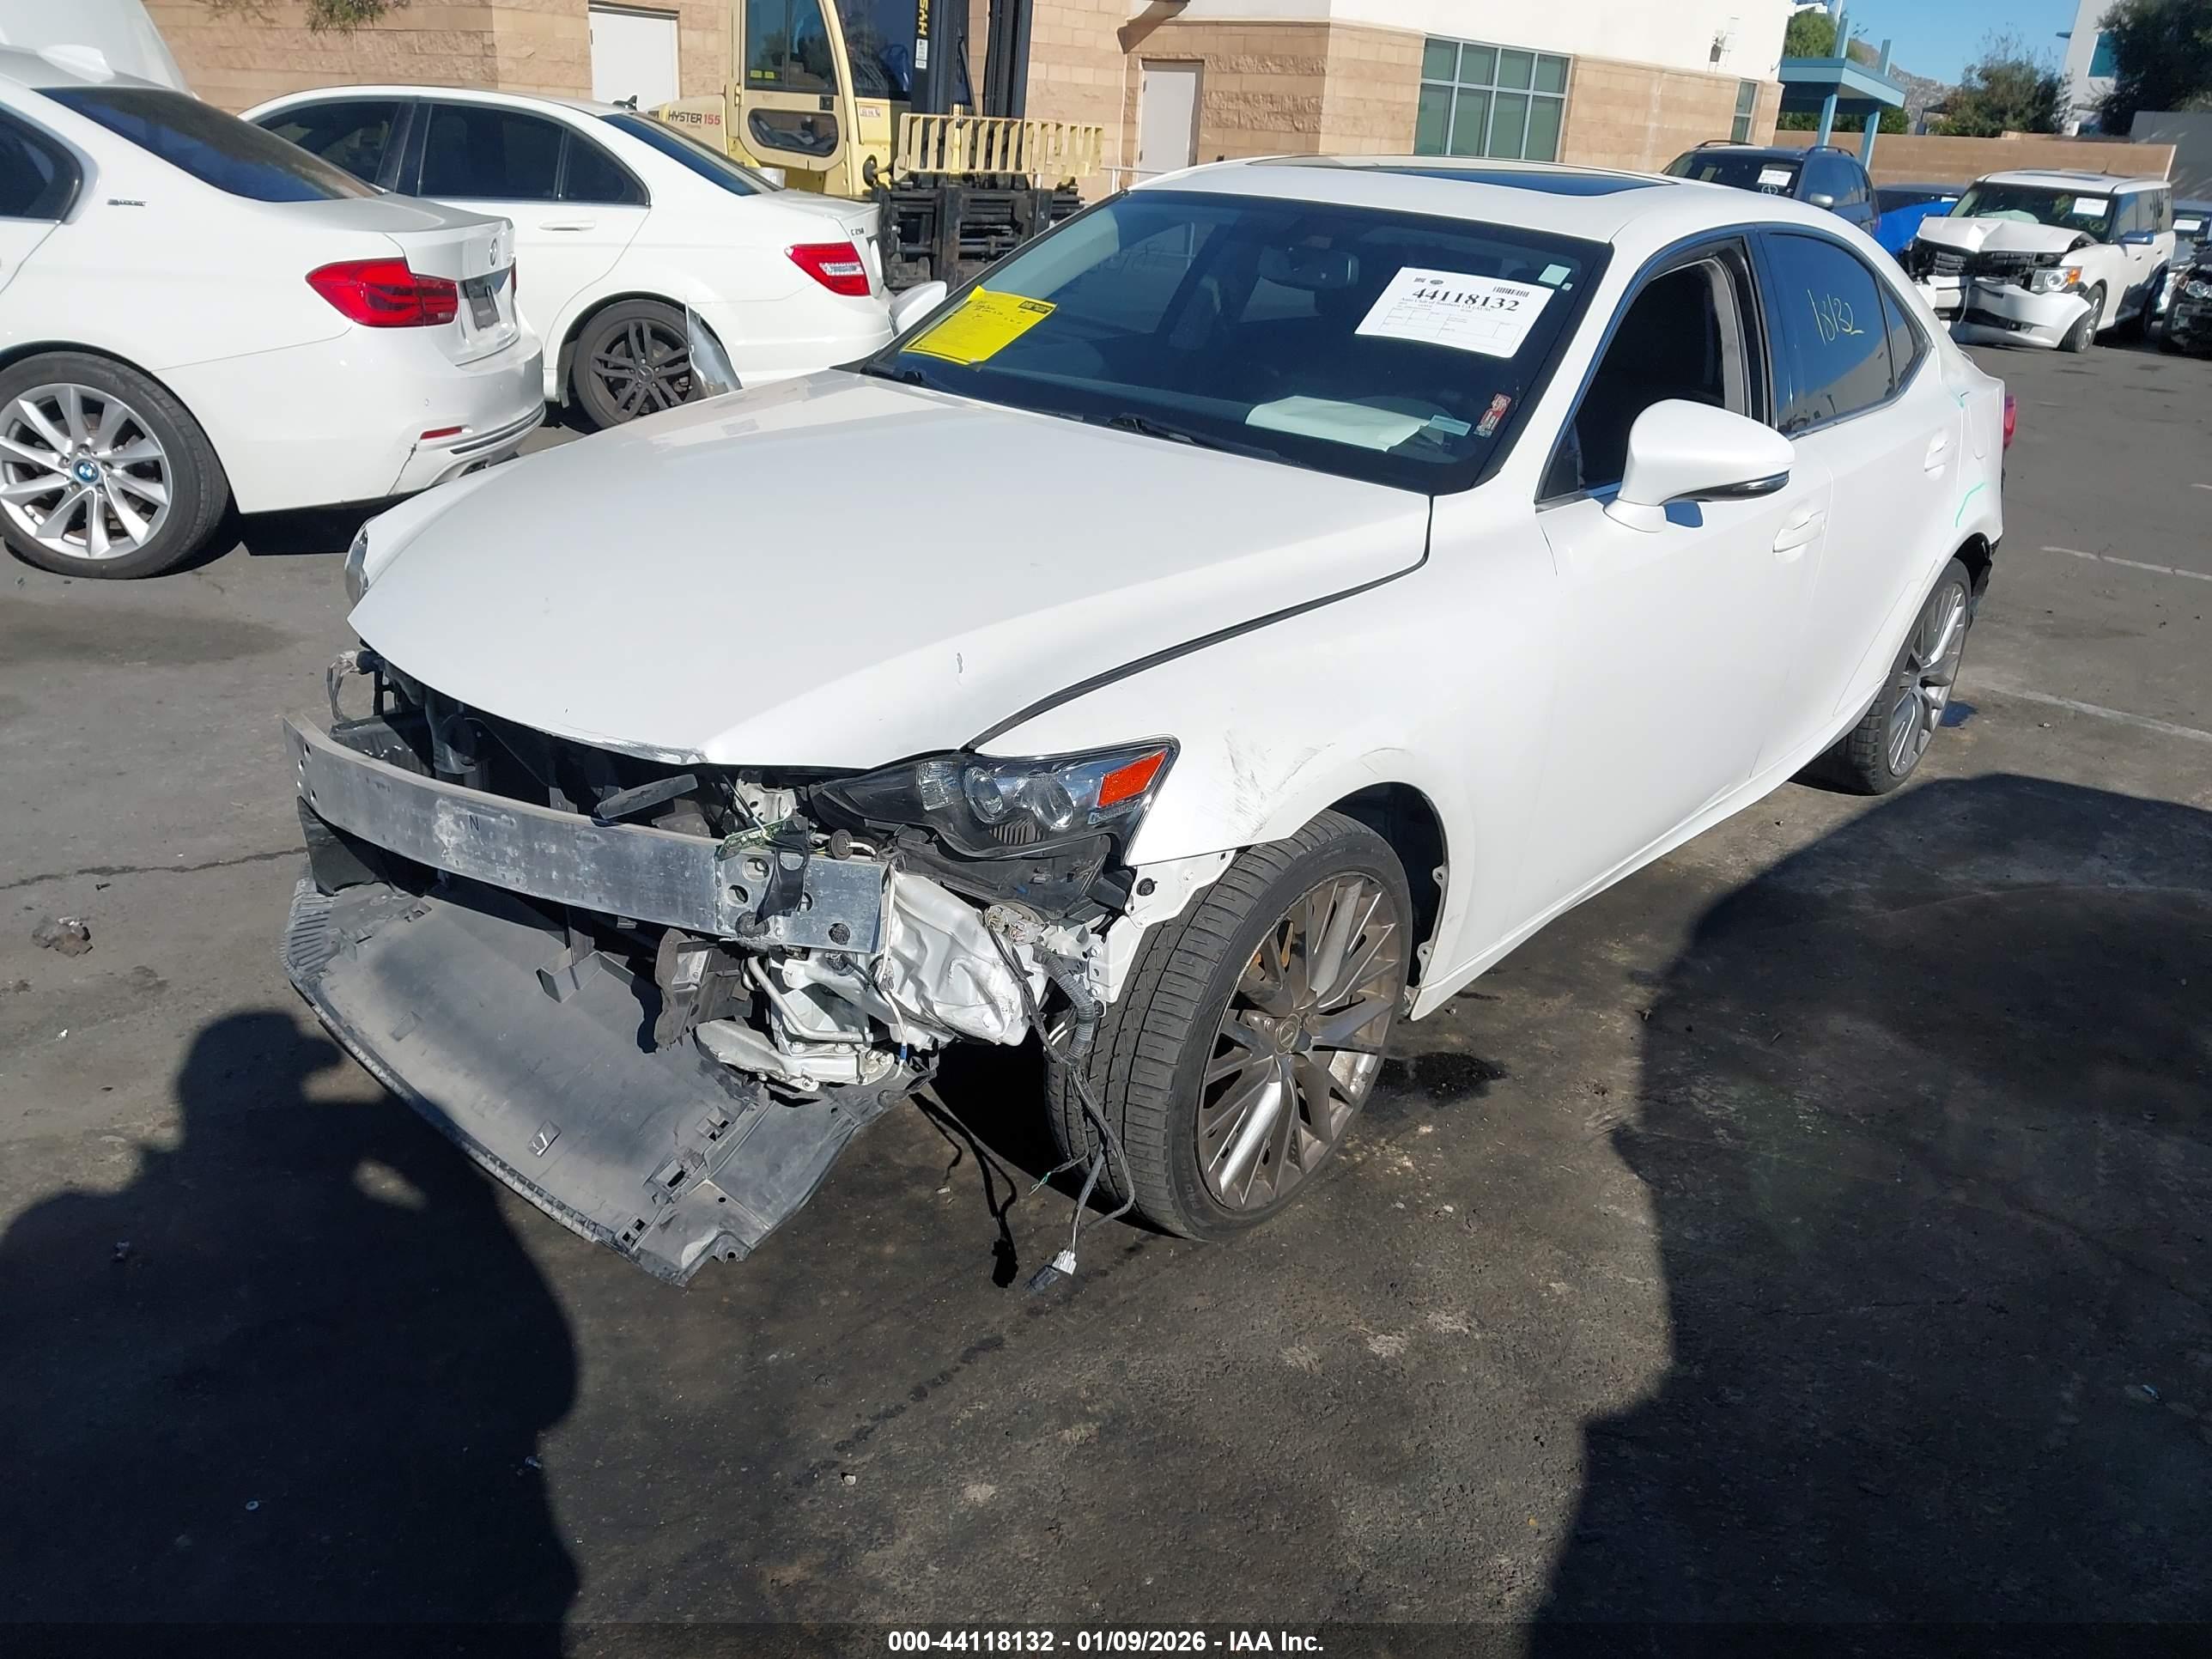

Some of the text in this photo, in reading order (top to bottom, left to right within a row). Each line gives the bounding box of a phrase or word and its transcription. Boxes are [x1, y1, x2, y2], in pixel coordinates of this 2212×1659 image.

[667, 110, 702, 125] HYSTER
[704, 113, 721, 125] 155
[1412, 288, 1520, 312] 44118132
